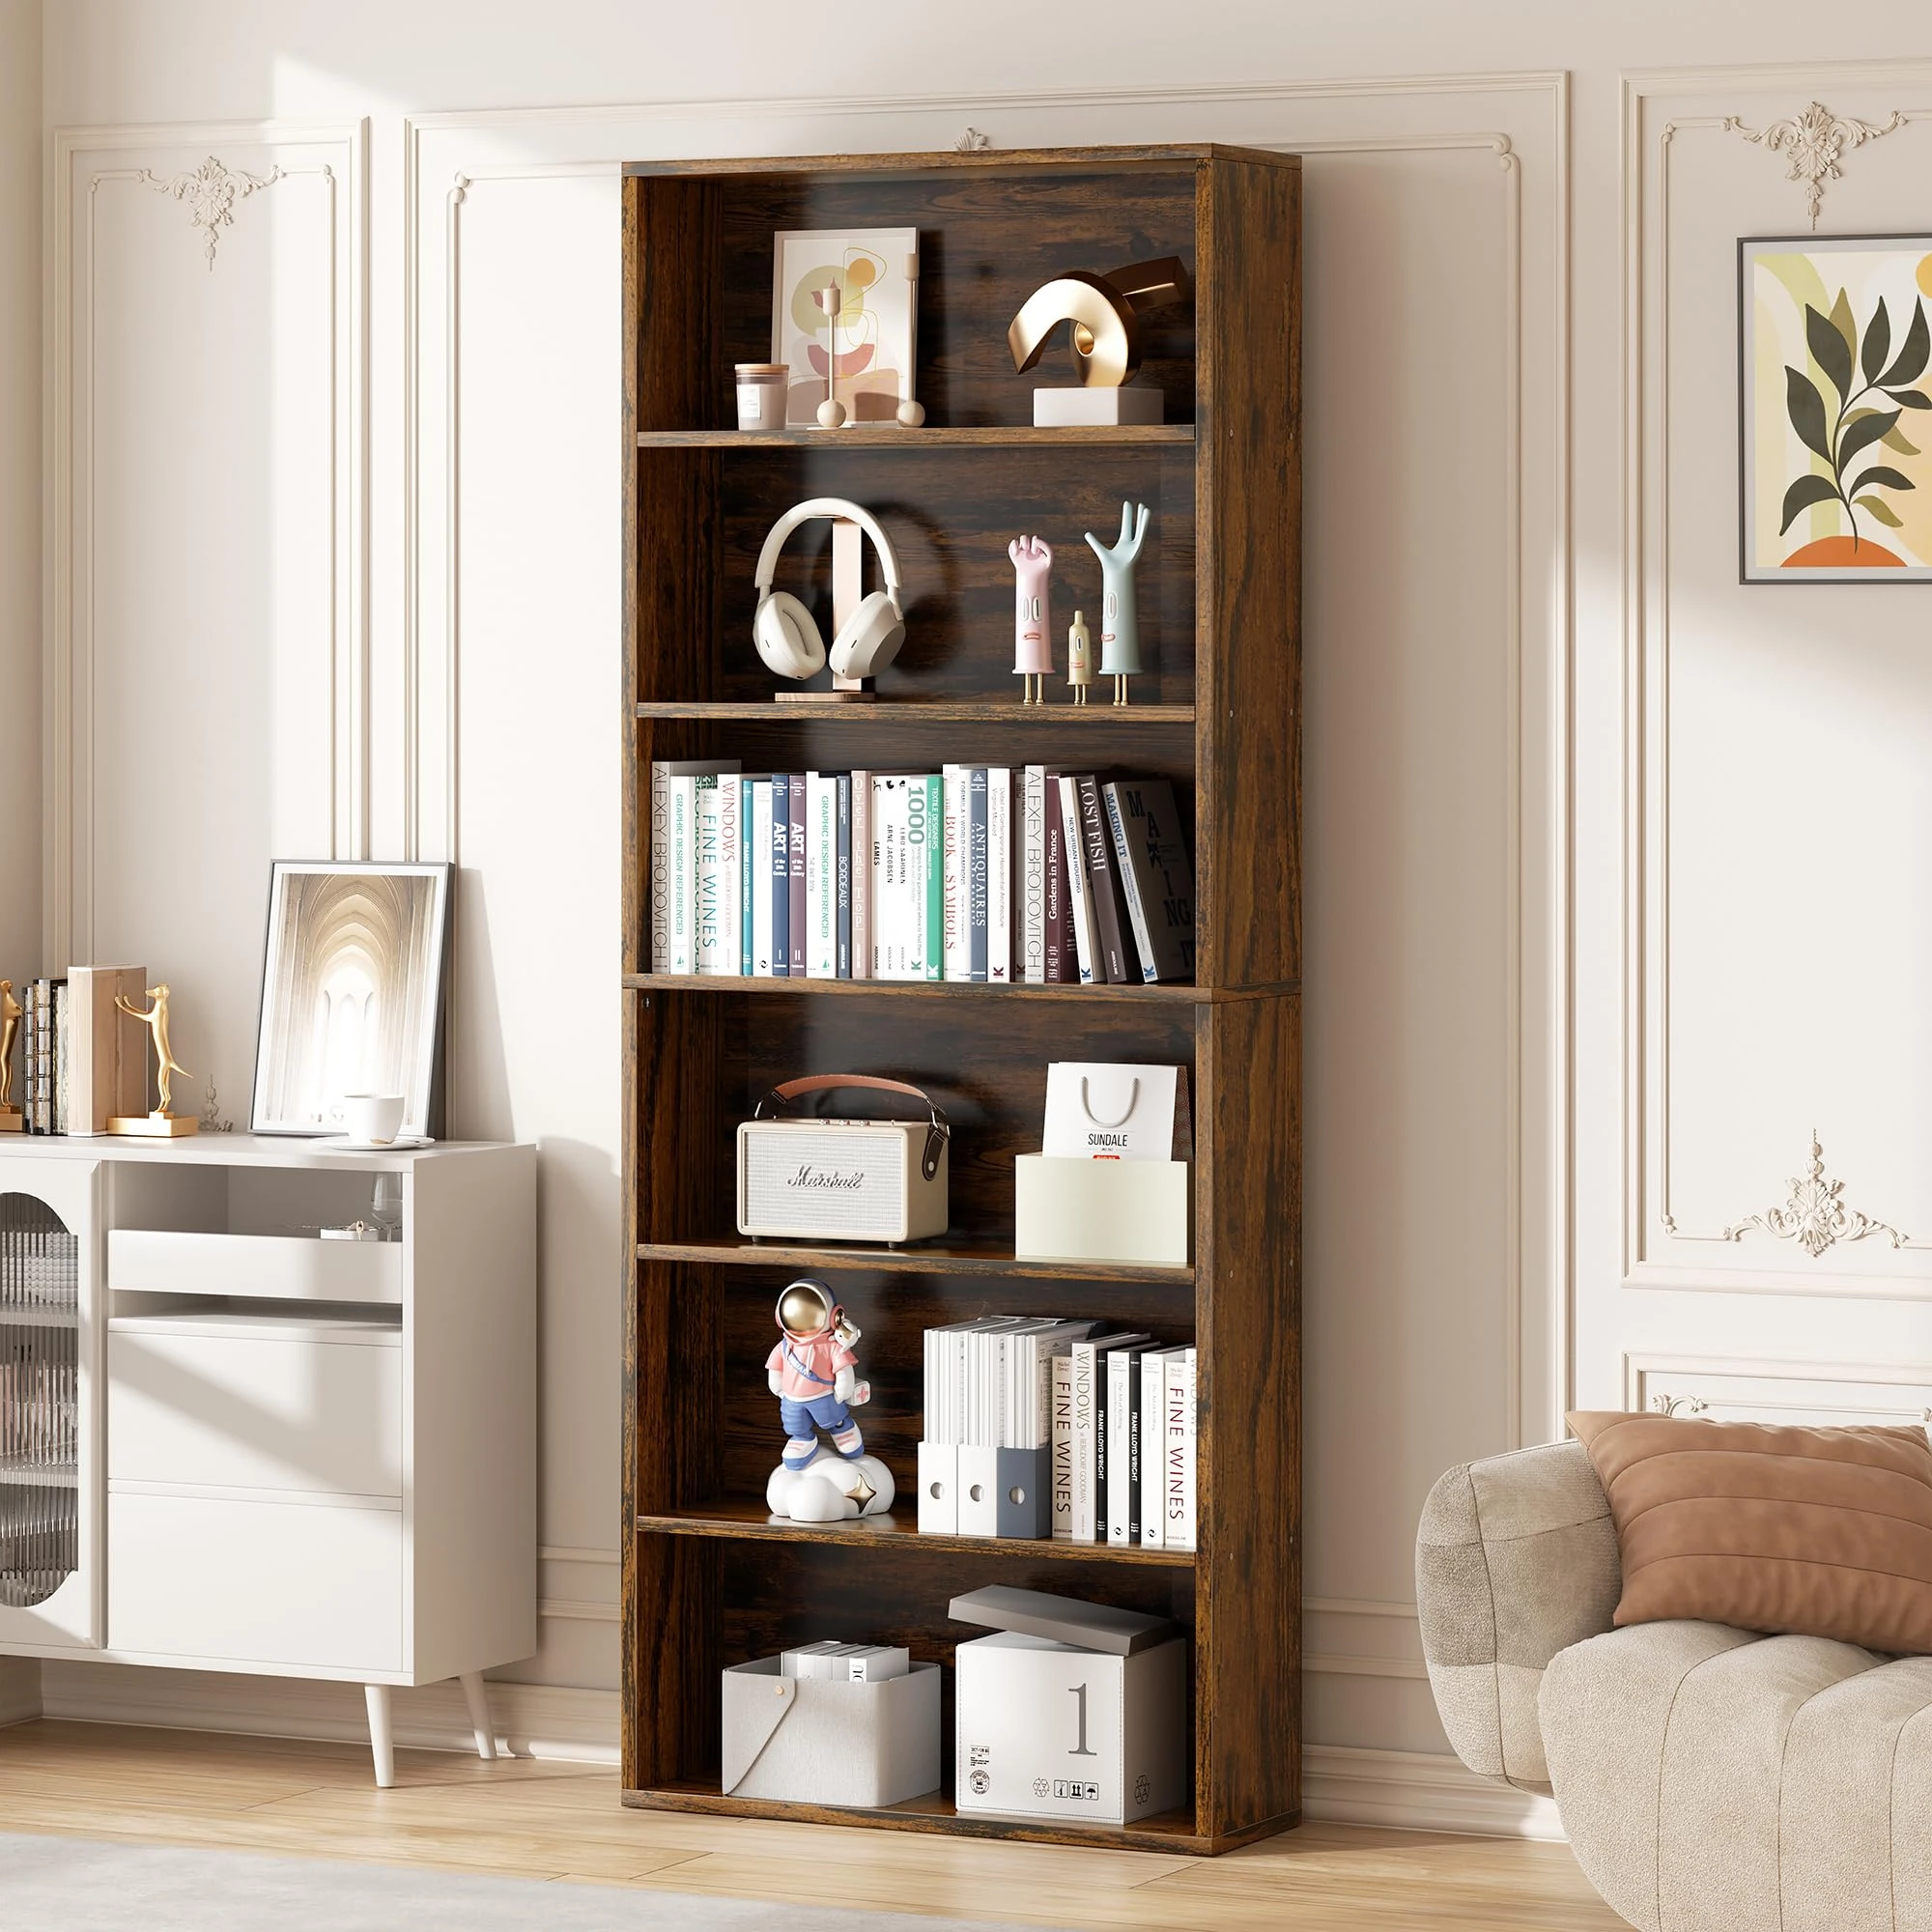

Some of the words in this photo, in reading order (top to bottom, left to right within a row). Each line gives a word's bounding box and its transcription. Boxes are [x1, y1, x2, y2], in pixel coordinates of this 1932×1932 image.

[654, 768, 667, 837] ALEXEY
[722, 781, 735, 863] WINDOWS
[908, 786, 924, 845] 1000
[1028, 771, 1041, 843] ALEXEY
[1080, 781, 1099, 829] LOST
[1106, 792, 1123, 842] MAKING
[1118, 844, 1127, 858] IT
[702, 815, 717, 864] FINE
[774, 821, 786, 855] ART
[791, 821, 804, 855] ART
[946, 816, 955, 858] BOOK
[1069, 834, 1078, 860] URBAN
[1086, 832, 1106, 871] FISH
[838, 856, 847, 908] BORDEAUX
[975, 822, 985, 926] ANTIQUAIRES
[1049, 866, 1057, 875] in
[1072, 861, 1082, 894] HOUSING
[654, 842, 667, 959] BRODOVITCH
[702, 875, 717, 948] WINES
[946, 875, 955, 950] SYMBOLS
[1028, 848, 1041, 968] BRODOVITCH
[1048, 878, 1058, 920] Gardens
[1088, 1133, 1128, 1147] SUNDALE
[787, 1165, 865, 1189] Marshall
[1057, 1381, 1070, 1430] FINE
[1076, 1350, 1090, 1430] WINDOWS
[1170, 1387, 1184, 1436] FINE
[1057, 1441, 1070, 1513] WINES
[1170, 1447, 1184, 1520] WINES
[1068, 1683, 1097, 1755] 1
